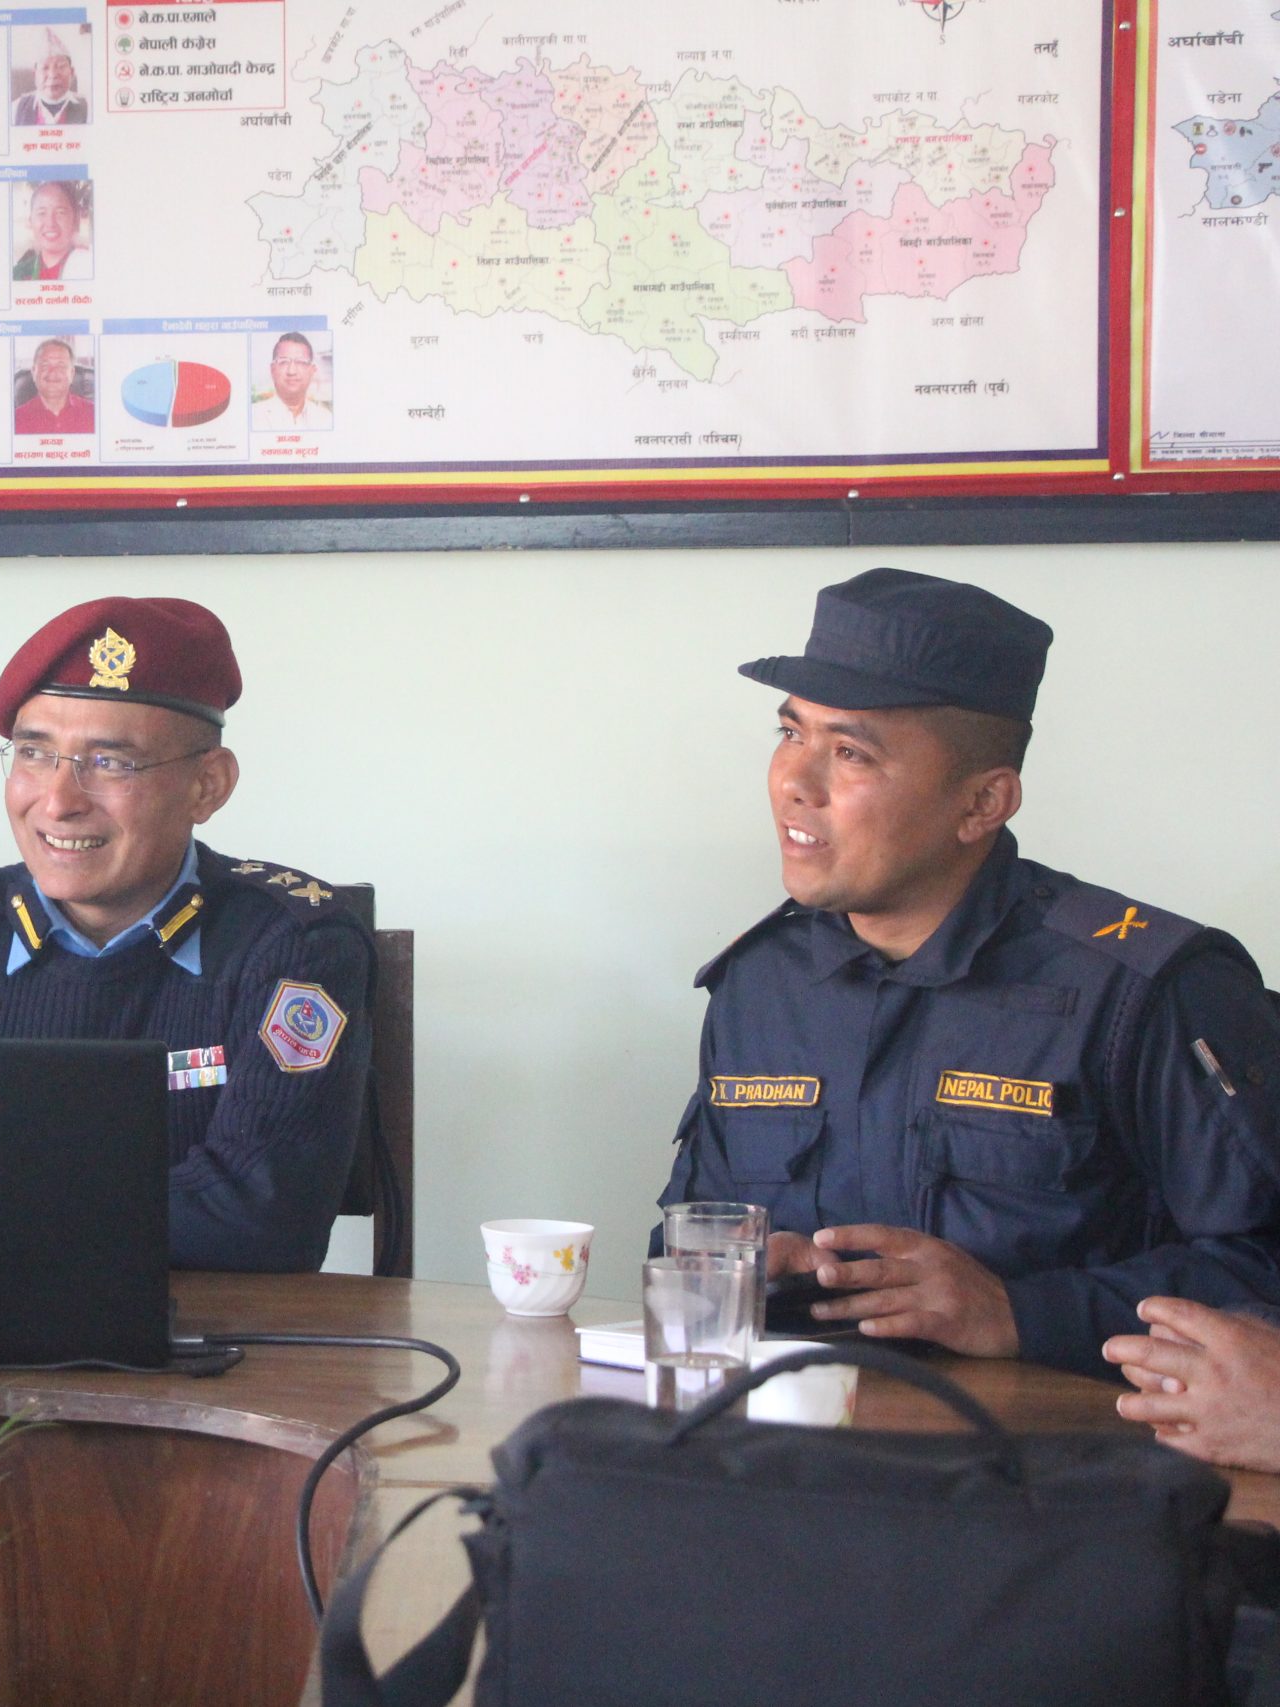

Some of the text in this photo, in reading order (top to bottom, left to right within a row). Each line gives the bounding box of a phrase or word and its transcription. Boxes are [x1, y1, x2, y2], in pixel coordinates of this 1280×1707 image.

[139, 36, 177, 50] नेपाली
[939, 34, 946, 45] S
[1168, 30, 1243, 47] अर्घाखाँची
[186, 61, 241, 75] माओवादी
[240, 111, 292, 126] अर्घाखाँची
[914, 379, 1010, 396] नवलपरासी (पूर्व)
[634, 433, 692, 446] नवलपरासी
[734, 1082, 805, 1100] PRADHAN
[942, 1076, 995, 1101] NEPAL
